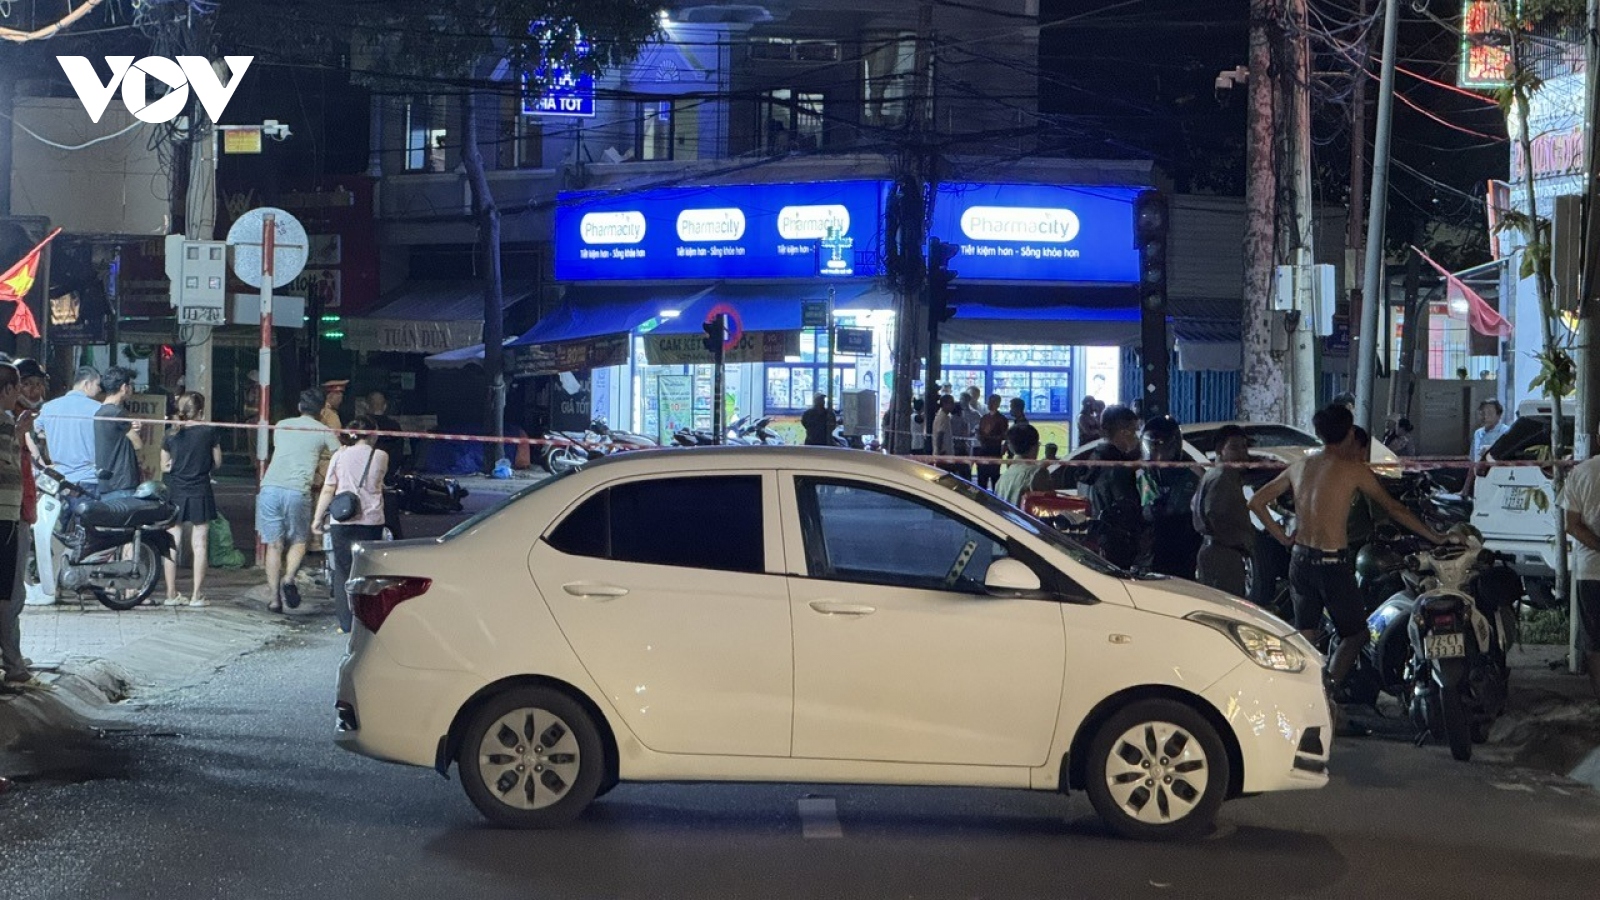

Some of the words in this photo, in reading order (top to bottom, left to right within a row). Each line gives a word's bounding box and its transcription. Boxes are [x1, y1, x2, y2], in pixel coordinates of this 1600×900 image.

[584, 217, 640, 239] Pharmacity
[681, 216, 740, 237] Pharmacity
[970, 213, 1070, 238] Pharmacity
[961, 244, 975, 256] Tiết
[976, 244, 996, 257] kiệm
[998, 245, 1014, 256] hơn
[1021, 245, 1041, 259] Sống
[1042, 246, 1062, 258] khỏe
[1063, 248, 1080, 258] hơn
